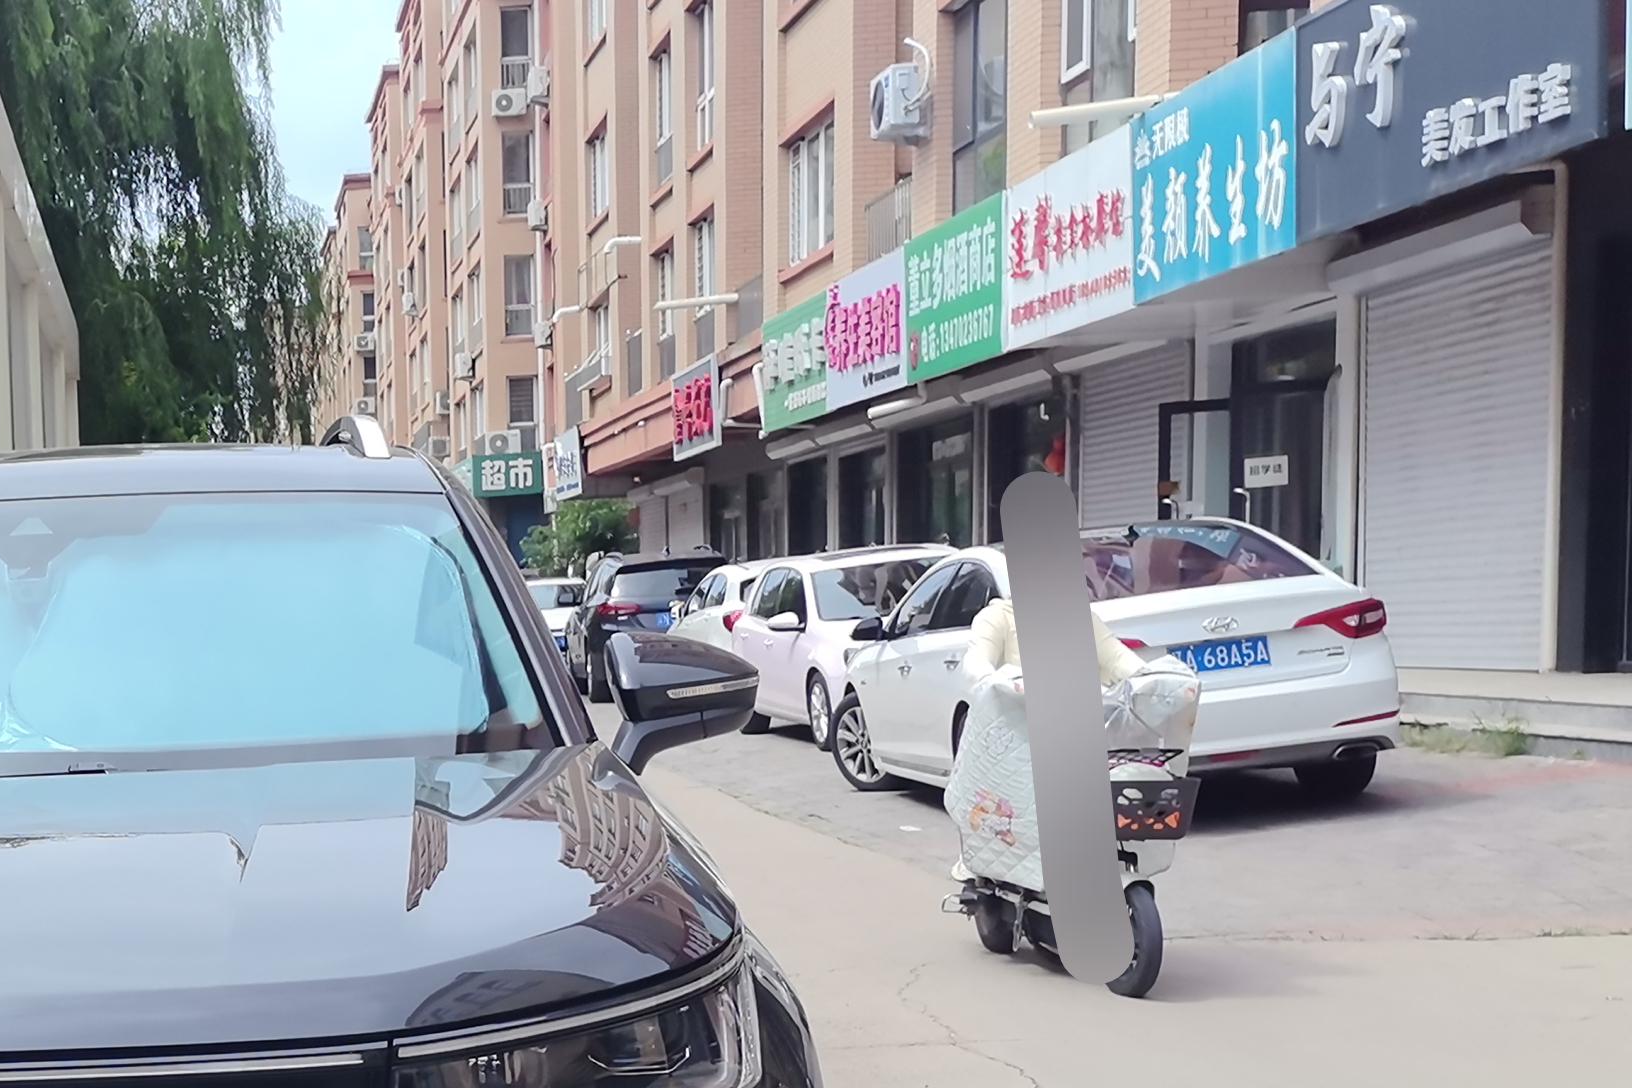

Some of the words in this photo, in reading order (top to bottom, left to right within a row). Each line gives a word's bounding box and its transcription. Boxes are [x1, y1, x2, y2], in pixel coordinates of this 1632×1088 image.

[1421, 63, 1572, 168] 美发工作室
[481, 459, 534, 491] 超市
